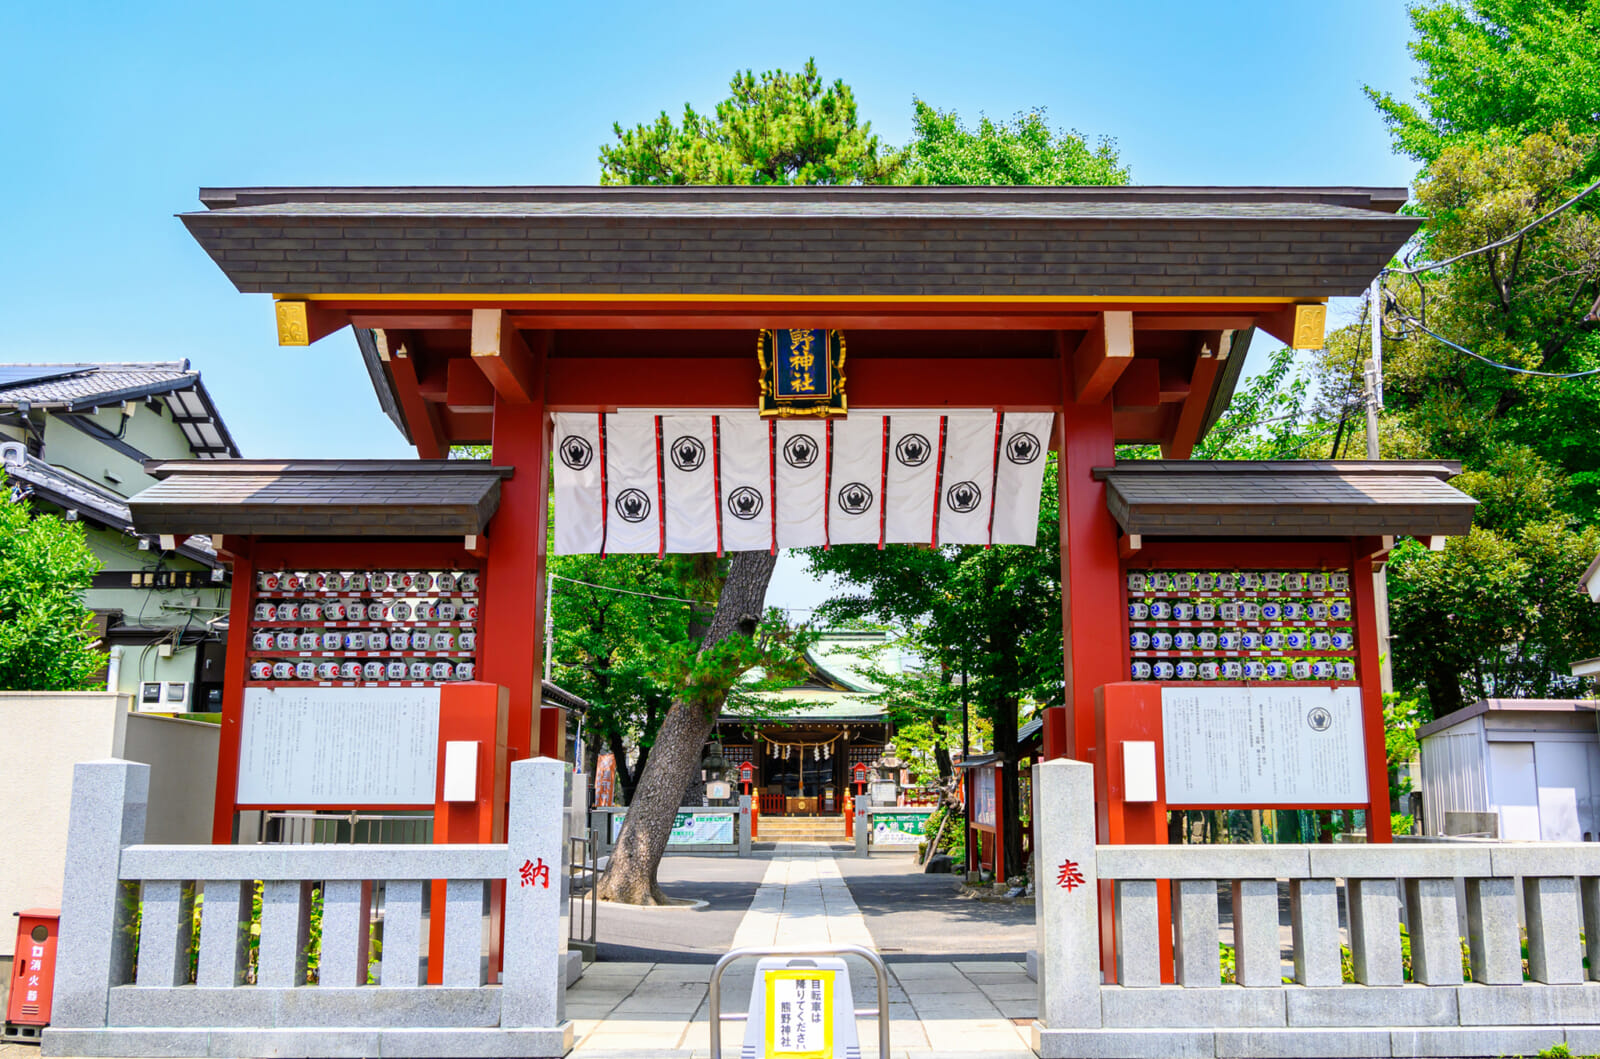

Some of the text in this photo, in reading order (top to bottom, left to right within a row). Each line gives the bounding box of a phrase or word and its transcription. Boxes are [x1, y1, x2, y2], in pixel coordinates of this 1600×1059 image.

[519, 858, 549, 890] 納
[1056, 859, 1086, 894] 奉
[796, 979, 806, 1049] 降りてください
[811, 980, 821, 1022] 自転車は
[781, 1002, 791, 1047] 熊野神社
